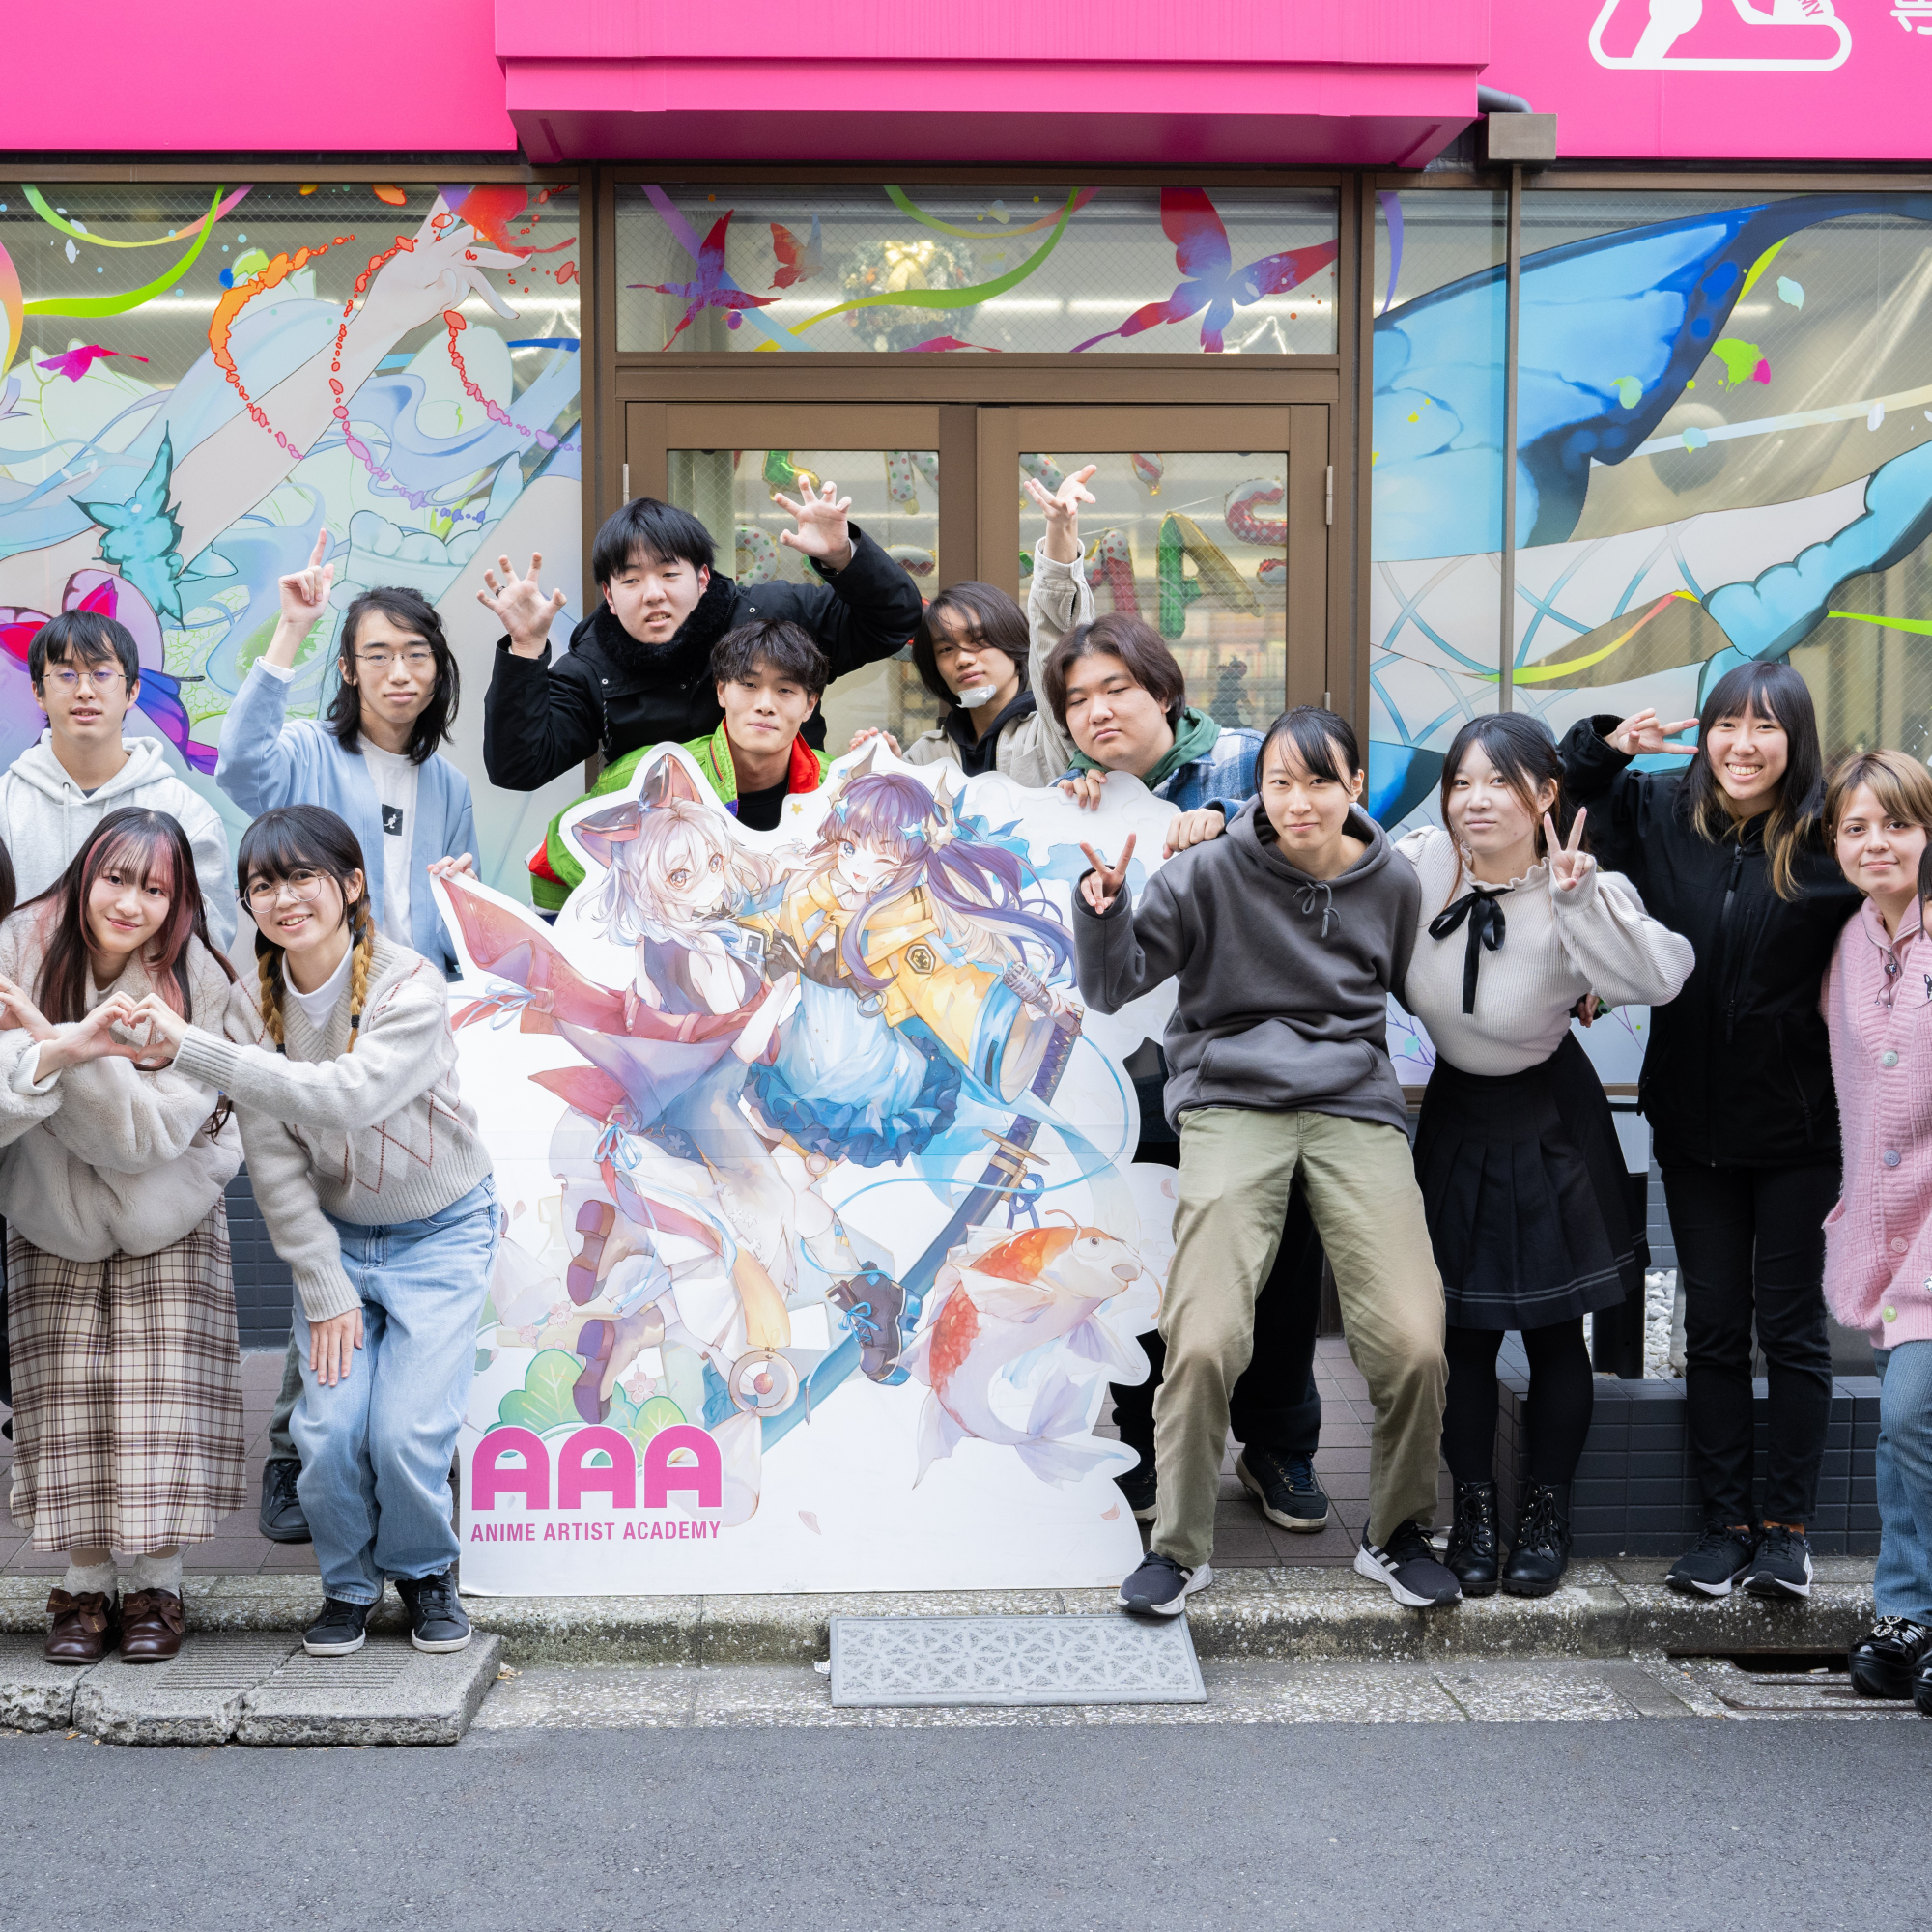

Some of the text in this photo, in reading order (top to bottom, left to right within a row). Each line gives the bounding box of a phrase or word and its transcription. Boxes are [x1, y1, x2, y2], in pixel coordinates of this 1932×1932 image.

[471, 1425, 723, 1511] AAA
[470, 1520, 721, 1542] ANIME ARTIST ACADEMY
